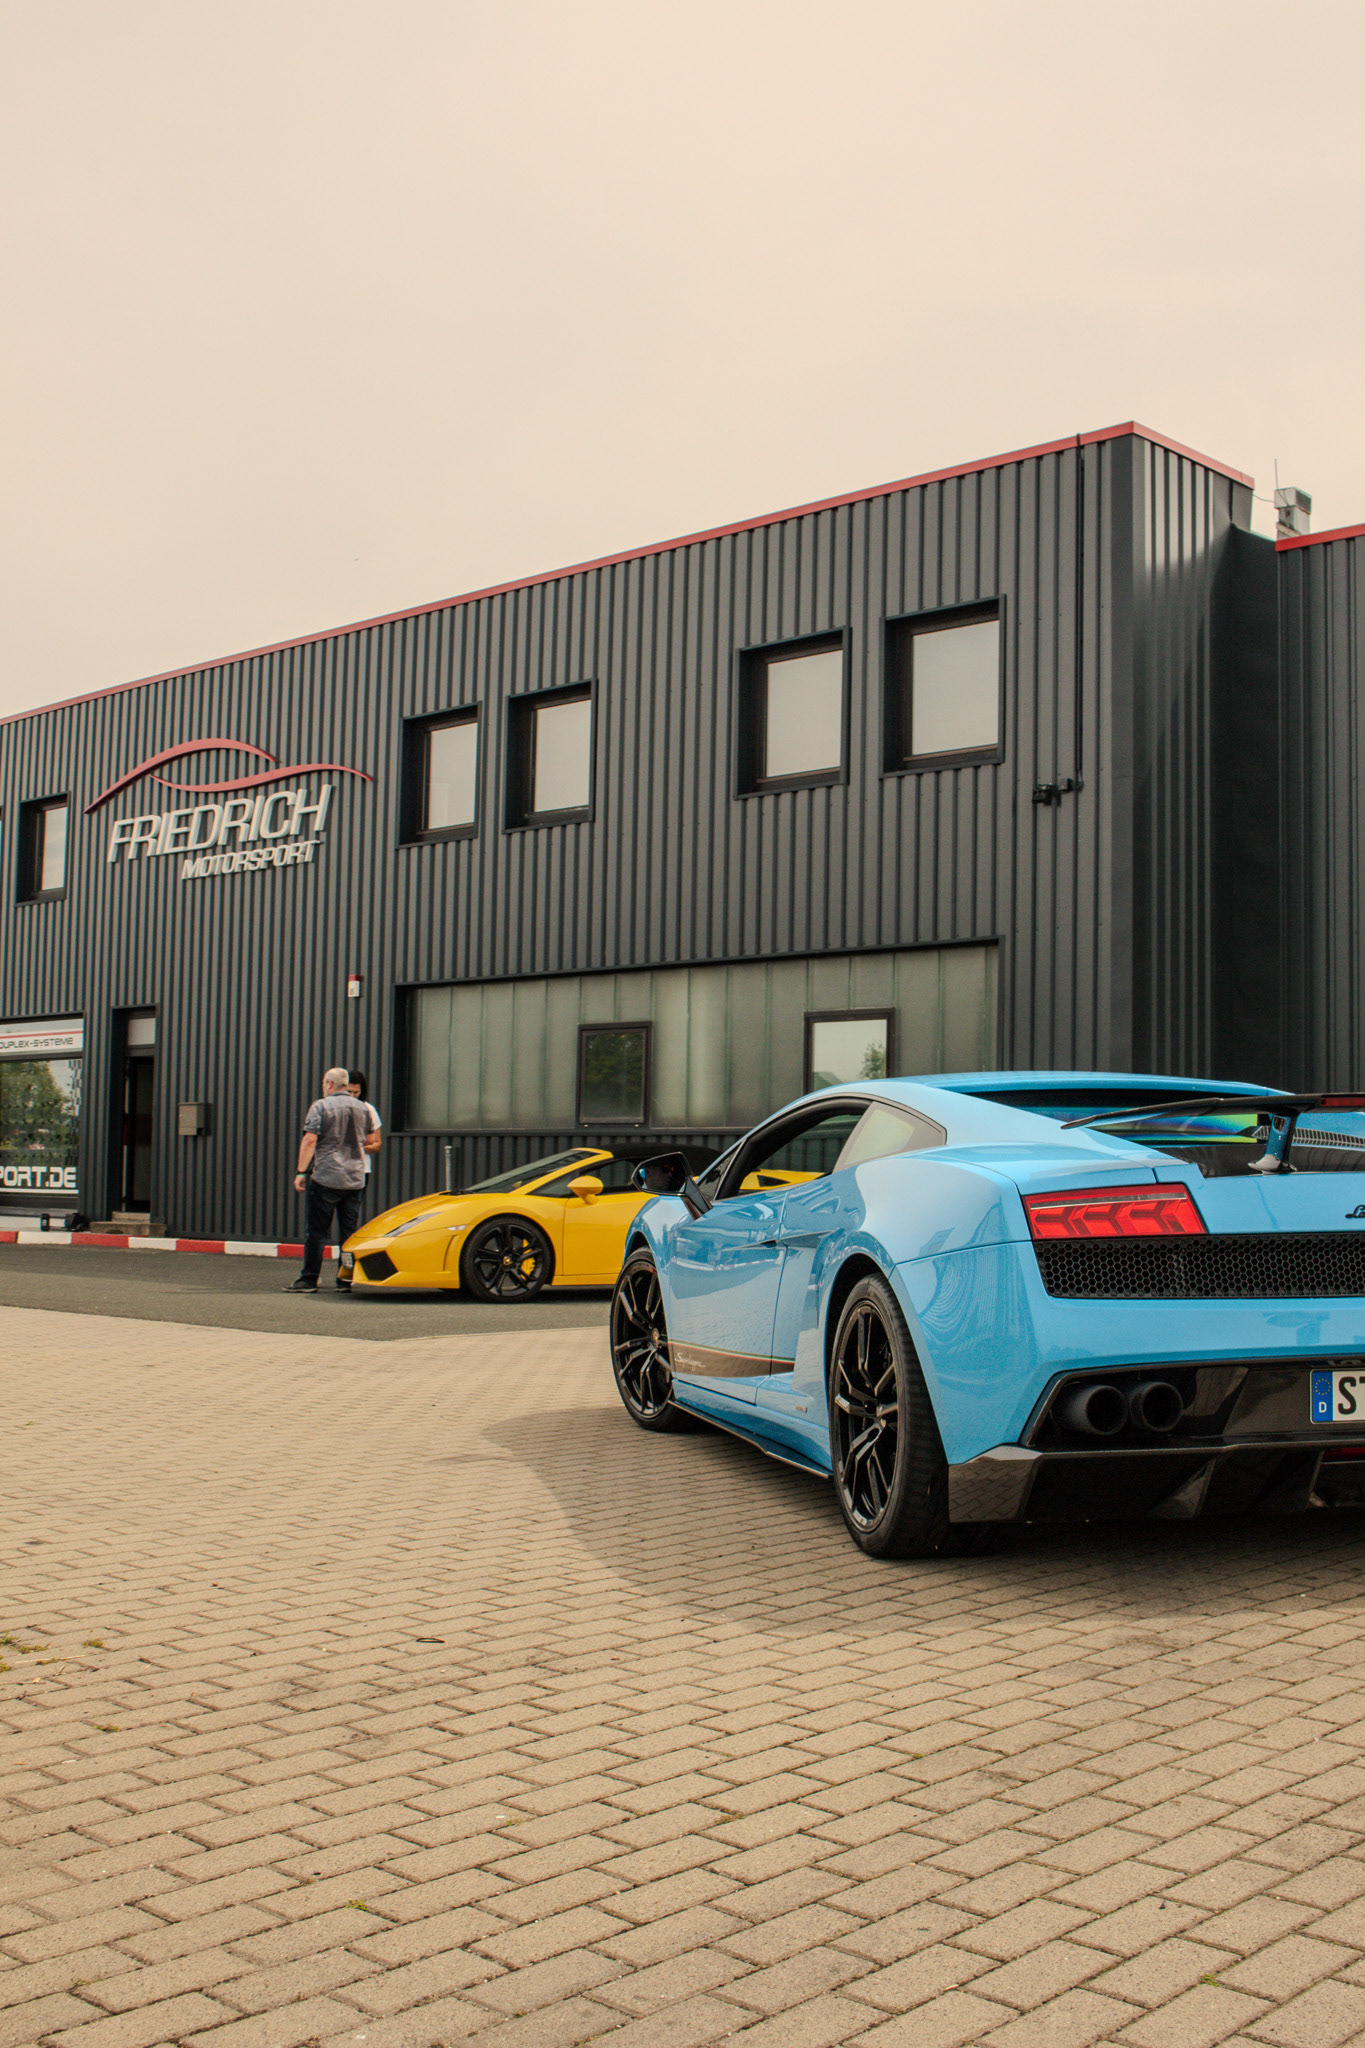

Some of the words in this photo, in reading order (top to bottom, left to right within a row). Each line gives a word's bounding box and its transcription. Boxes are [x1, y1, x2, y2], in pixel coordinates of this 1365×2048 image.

[107, 784, 333, 863] FRIEDRICH
[181, 840, 323, 880] MOTORSPORT
[1319, 1401, 1327, 1413] D
